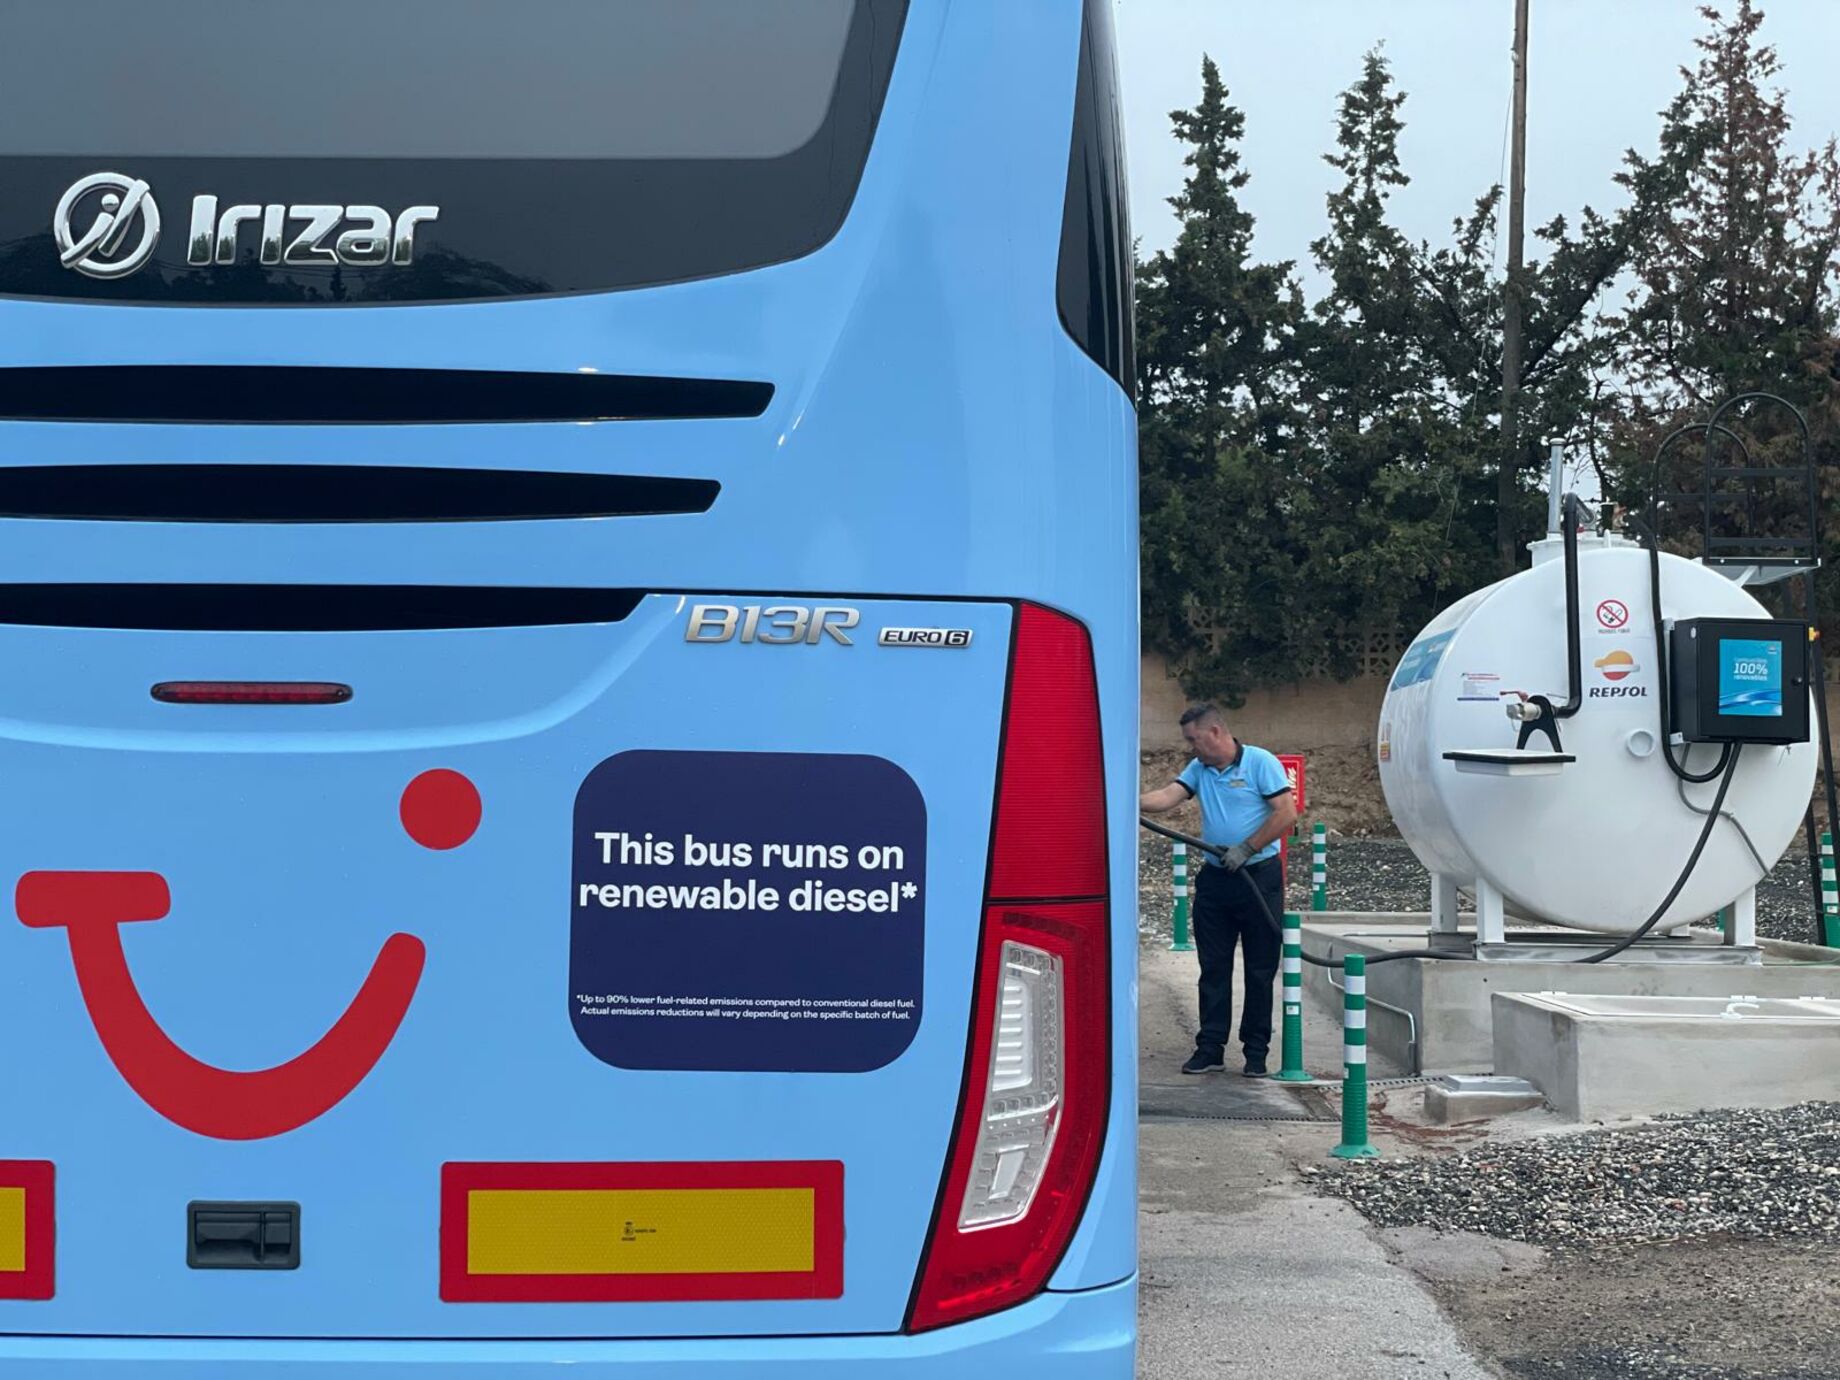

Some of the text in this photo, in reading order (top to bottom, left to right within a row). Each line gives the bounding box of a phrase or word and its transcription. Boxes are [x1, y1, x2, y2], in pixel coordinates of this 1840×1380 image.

[186, 194, 440, 266] Irizar
[685, 604, 860, 645] B13R
[883, 630, 968, 645] EURO 6
[1733, 662, 1768, 675] 100%
[1589, 686, 1648, 698] REPSOL
[594, 831, 904, 870] This bus runs on
[579, 878, 780, 911] renewable
[595, 996, 605, 1004] to
[606, 995, 629, 1004] 90%
[630, 996, 655, 1004] lower
[656, 996, 708, 1005] fuel-related
[709, 998, 753, 1006] emissions
[754, 998, 800, 1008] compared
[801, 999, 811, 1007] to
[813, 999, 868, 1007] conventional
[870, 999, 895, 1008] diesel
[897, 999, 915, 1008] fuel.
[580, 1006, 609, 1015] Actual
[611, 1008, 655, 1016] emissions
[656, 1008, 704, 1017] reductions
[705, 1009, 720, 1017] will
[721, 1010, 741, 1019] vary
[742, 1010, 789, 1020] depending
[803, 1010, 818, 1018] the
[819, 1011, 853, 1020] specific
[854, 1011, 880, 1019] batch
[881, 1011, 891, 1019] of
[892, 1011, 911, 1020] fuel.
